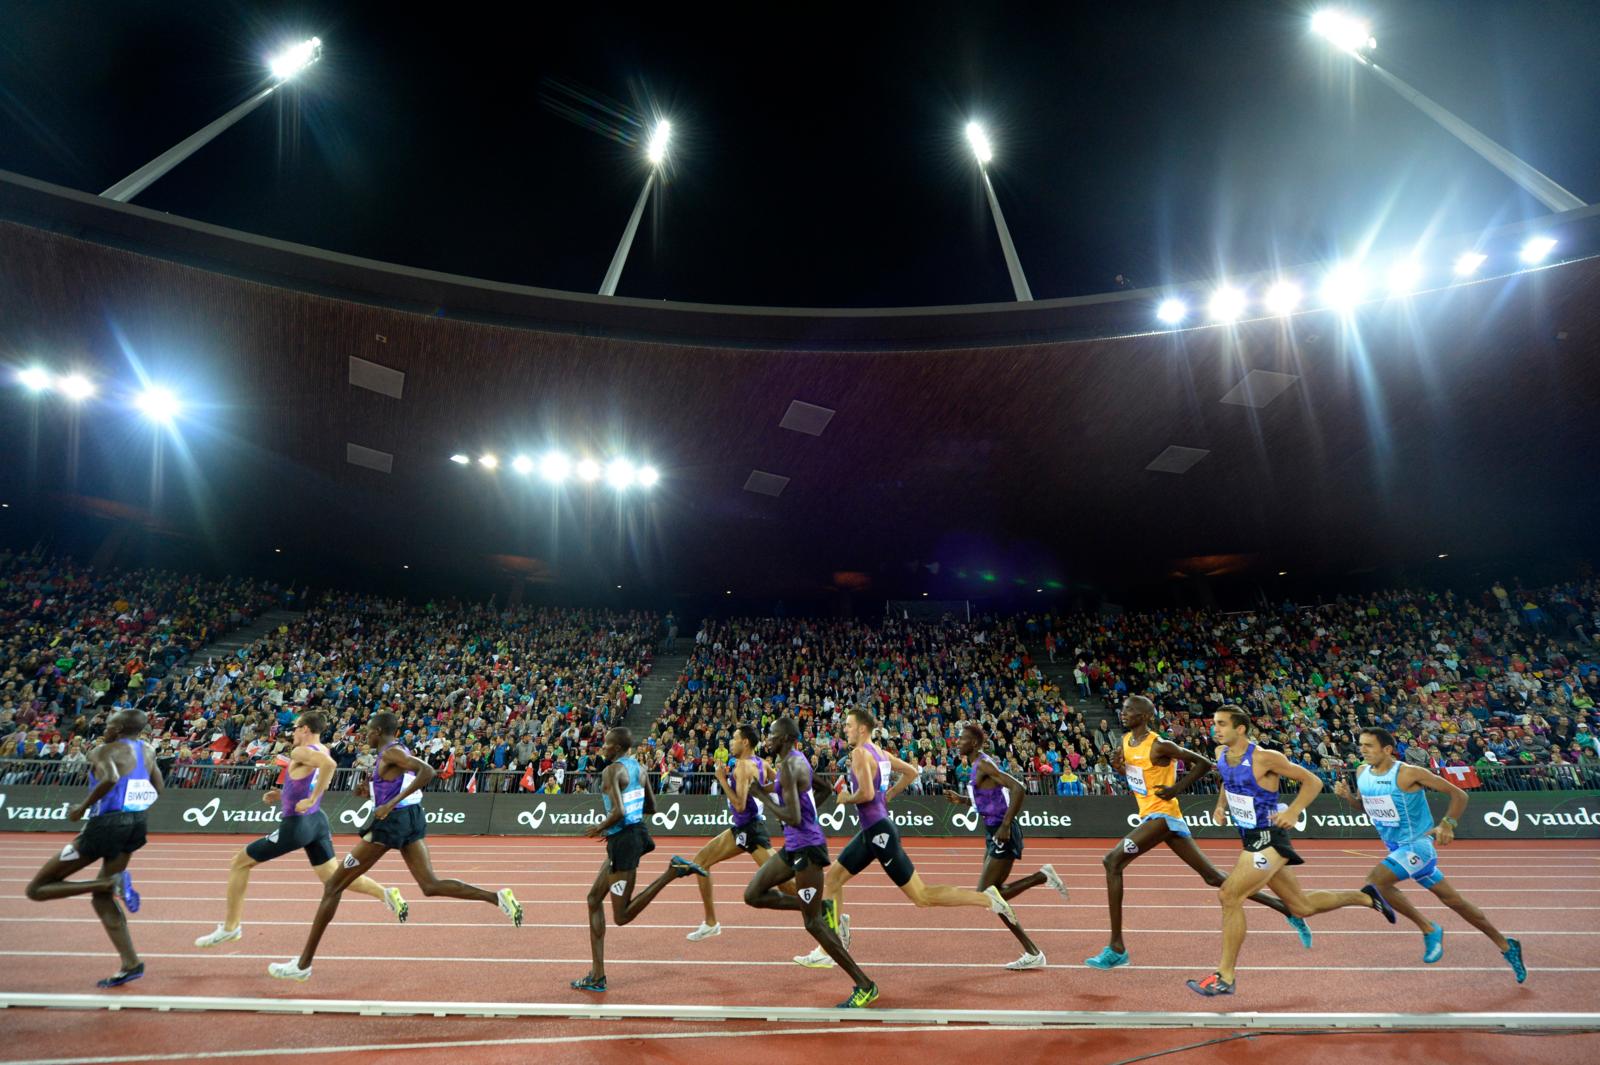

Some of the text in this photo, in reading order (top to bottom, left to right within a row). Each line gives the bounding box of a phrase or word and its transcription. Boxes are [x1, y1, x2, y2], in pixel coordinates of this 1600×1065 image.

[423, 808, 466, 824] oise
[1015, 811, 1072, 827] doise
[1312, 810, 1376, 827] vaud
[878, 835, 886, 846] 4
[1125, 841, 1137, 853] 12
[345, 856, 356, 867] 10
[1255, 857, 1267, 868] 2
[1410, 855, 1421, 865] 5
[804, 889, 811, 901] 6
